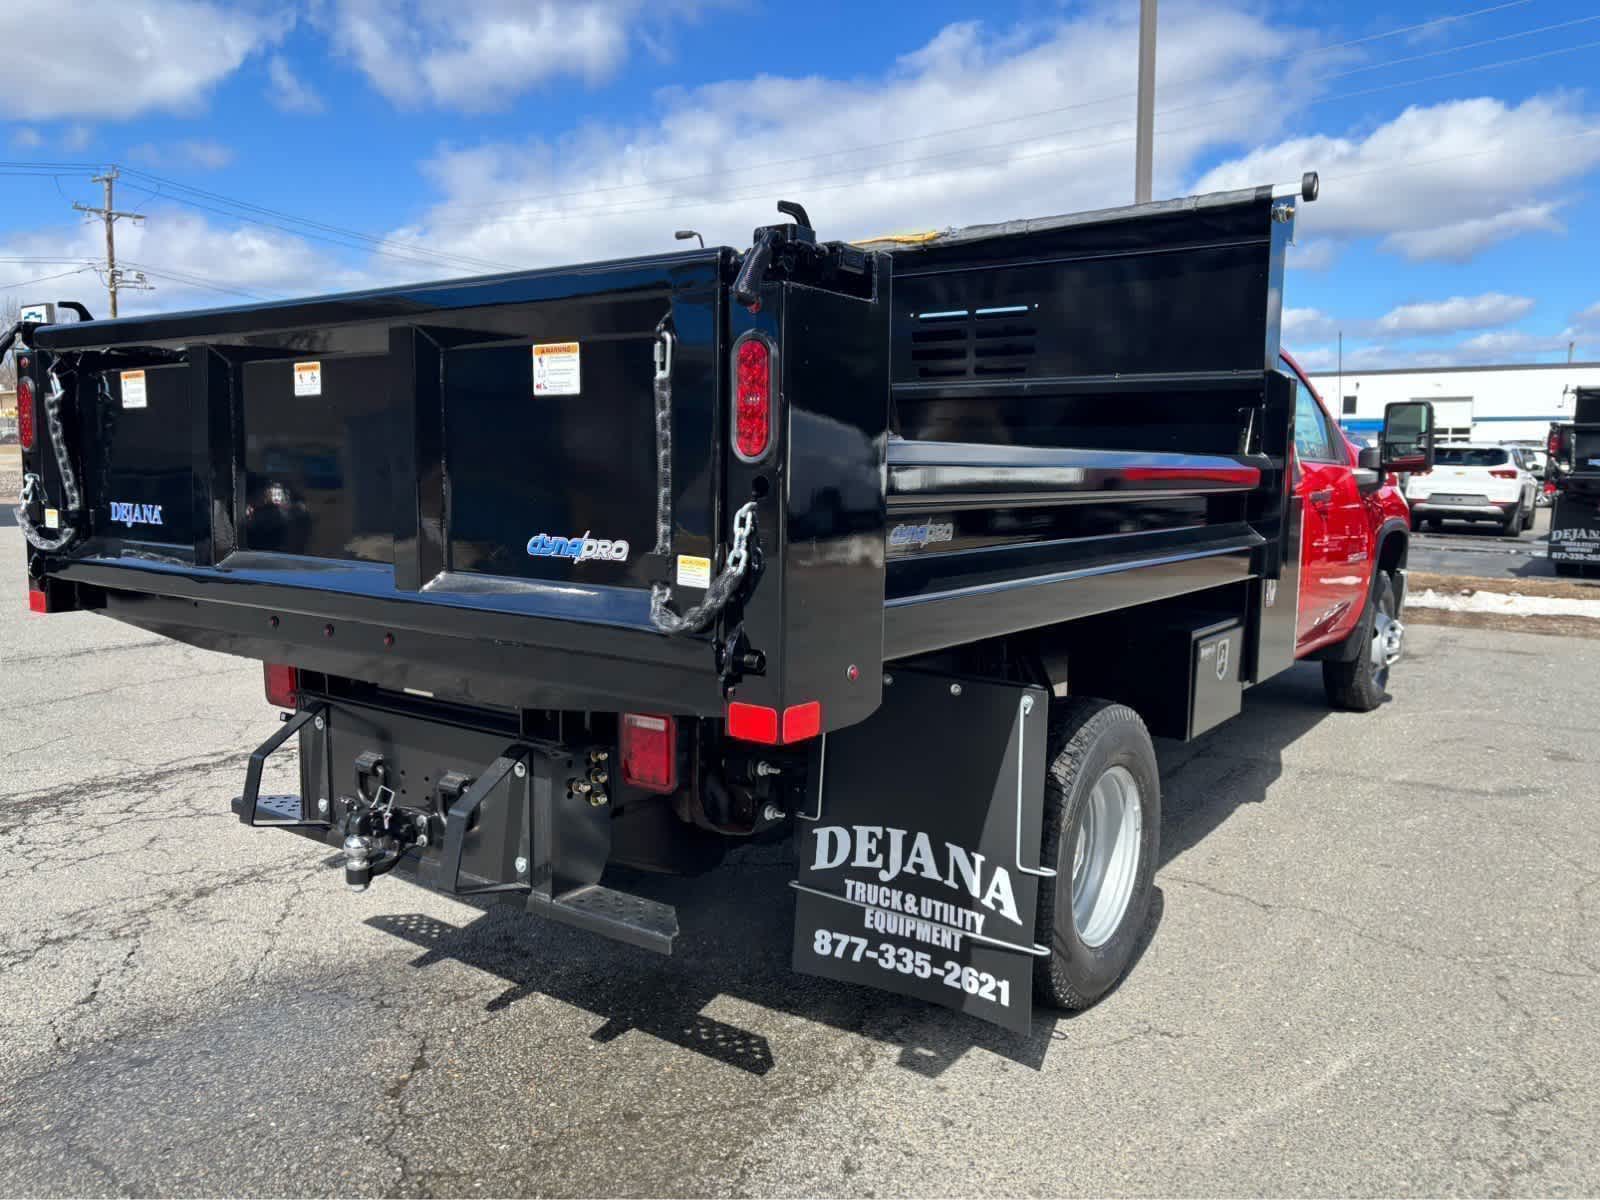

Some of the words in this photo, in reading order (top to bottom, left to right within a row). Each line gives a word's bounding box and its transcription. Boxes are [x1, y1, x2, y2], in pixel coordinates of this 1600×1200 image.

[110, 501, 163, 527] DEJANA
[810, 825, 1023, 926] DEJANA
[864, 908, 963, 952] EQUIPMENT
[813, 929, 1010, 1007] 877-335-2621
